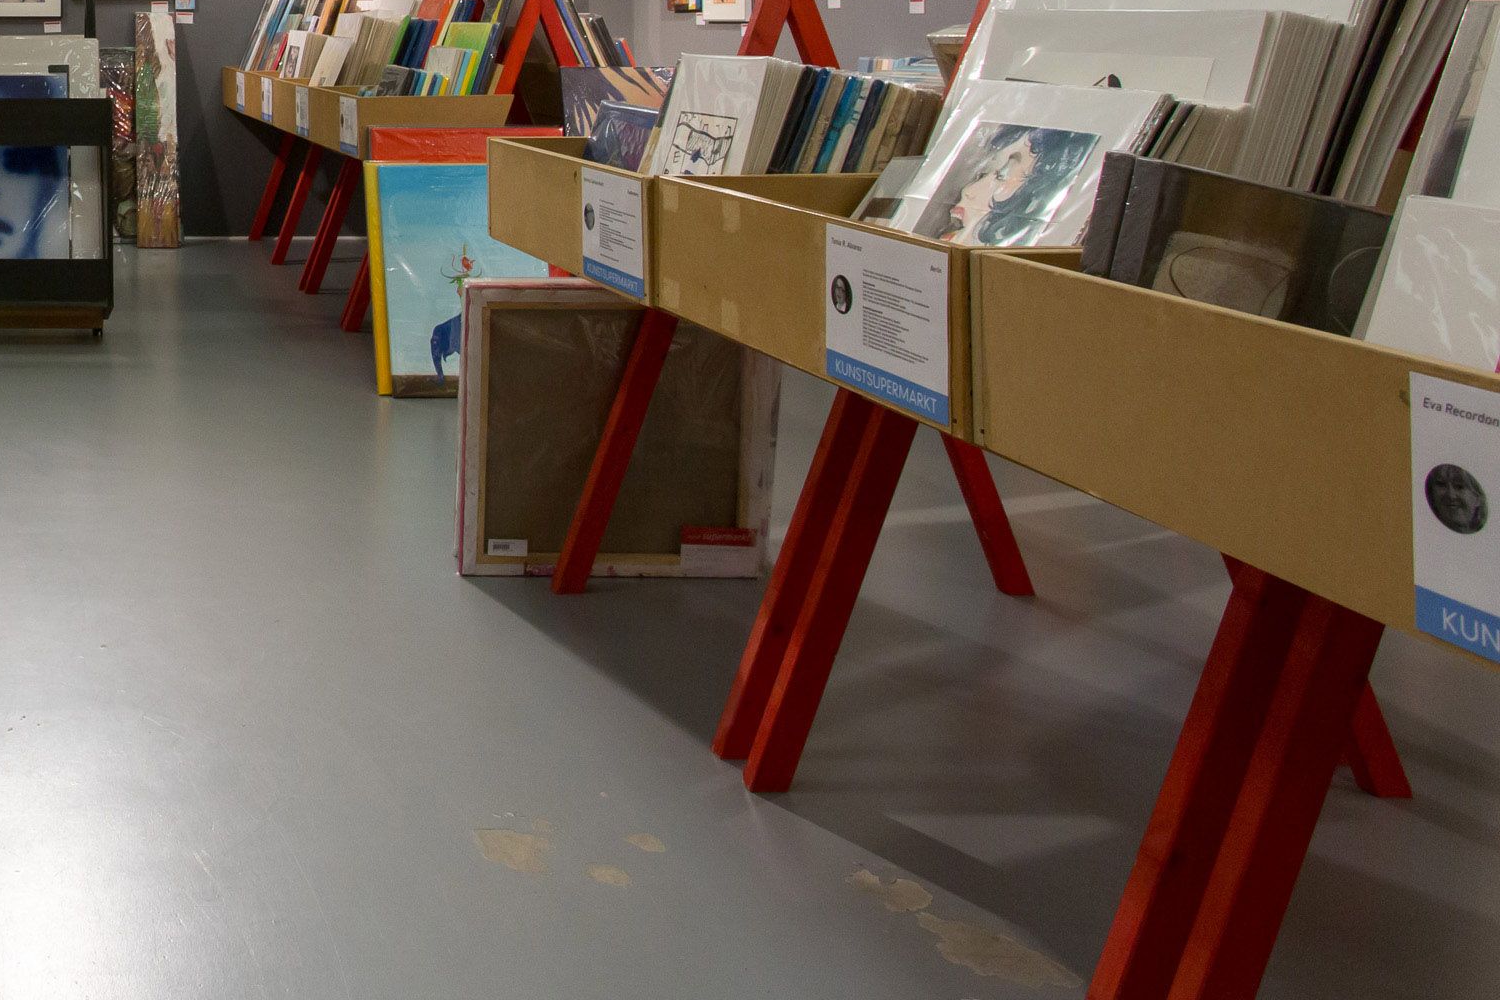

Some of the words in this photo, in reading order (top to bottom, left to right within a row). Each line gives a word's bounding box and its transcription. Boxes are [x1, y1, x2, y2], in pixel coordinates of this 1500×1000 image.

[835, 358, 937, 414] KUNSTSUPERMARKT
[1423, 397, 1442, 411] Eva
[1445, 402, 1500, 427] Recordon
[1442, 606, 1500, 653] KUN
